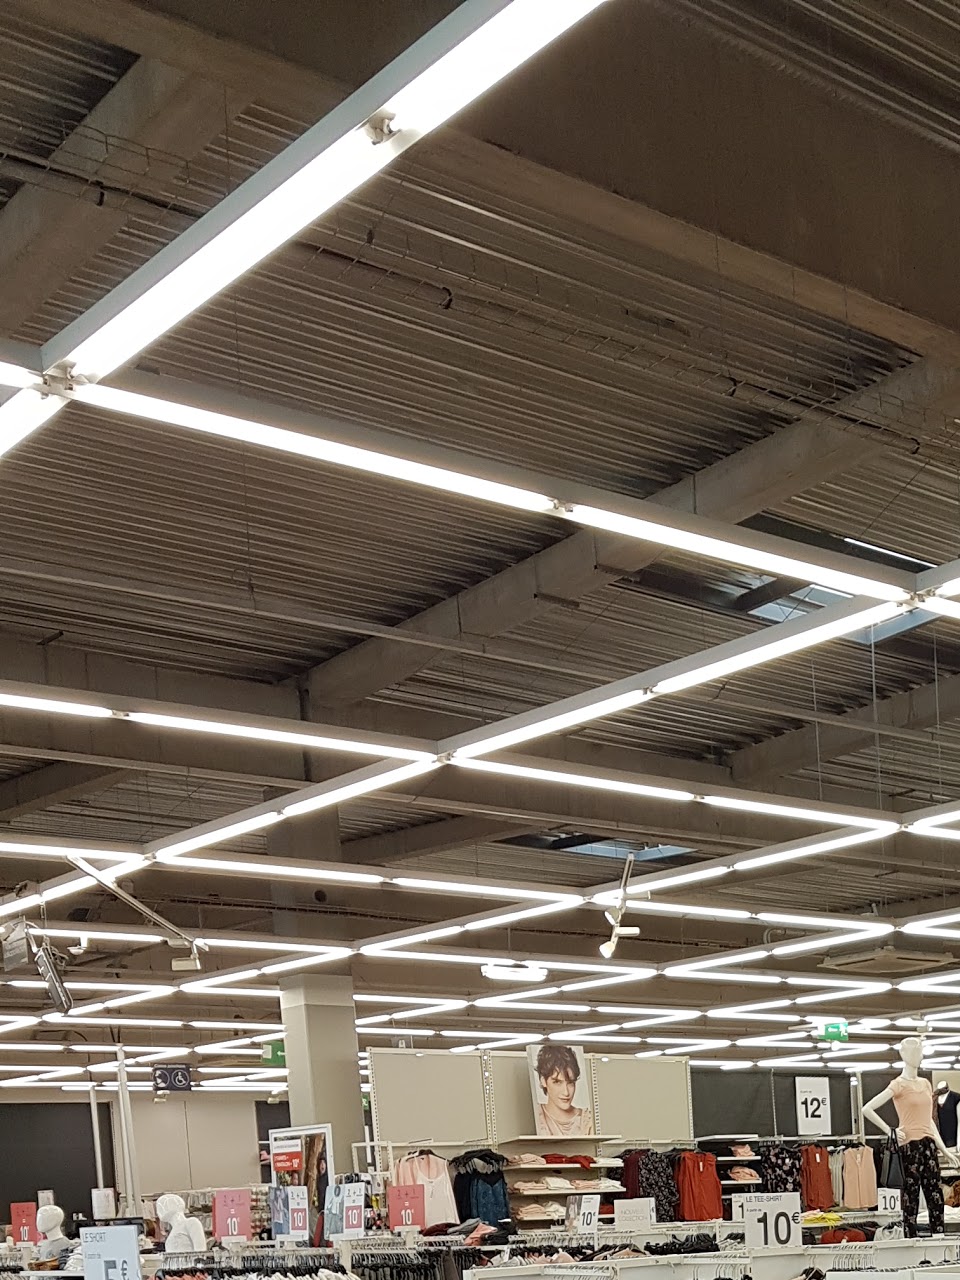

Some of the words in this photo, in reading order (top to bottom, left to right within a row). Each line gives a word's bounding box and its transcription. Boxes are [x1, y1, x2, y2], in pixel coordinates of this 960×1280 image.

[801, 1097, 827, 1118] 12€
[882, 1195, 899, 1210] 10€
[757, 1211, 800, 1245] 10€
